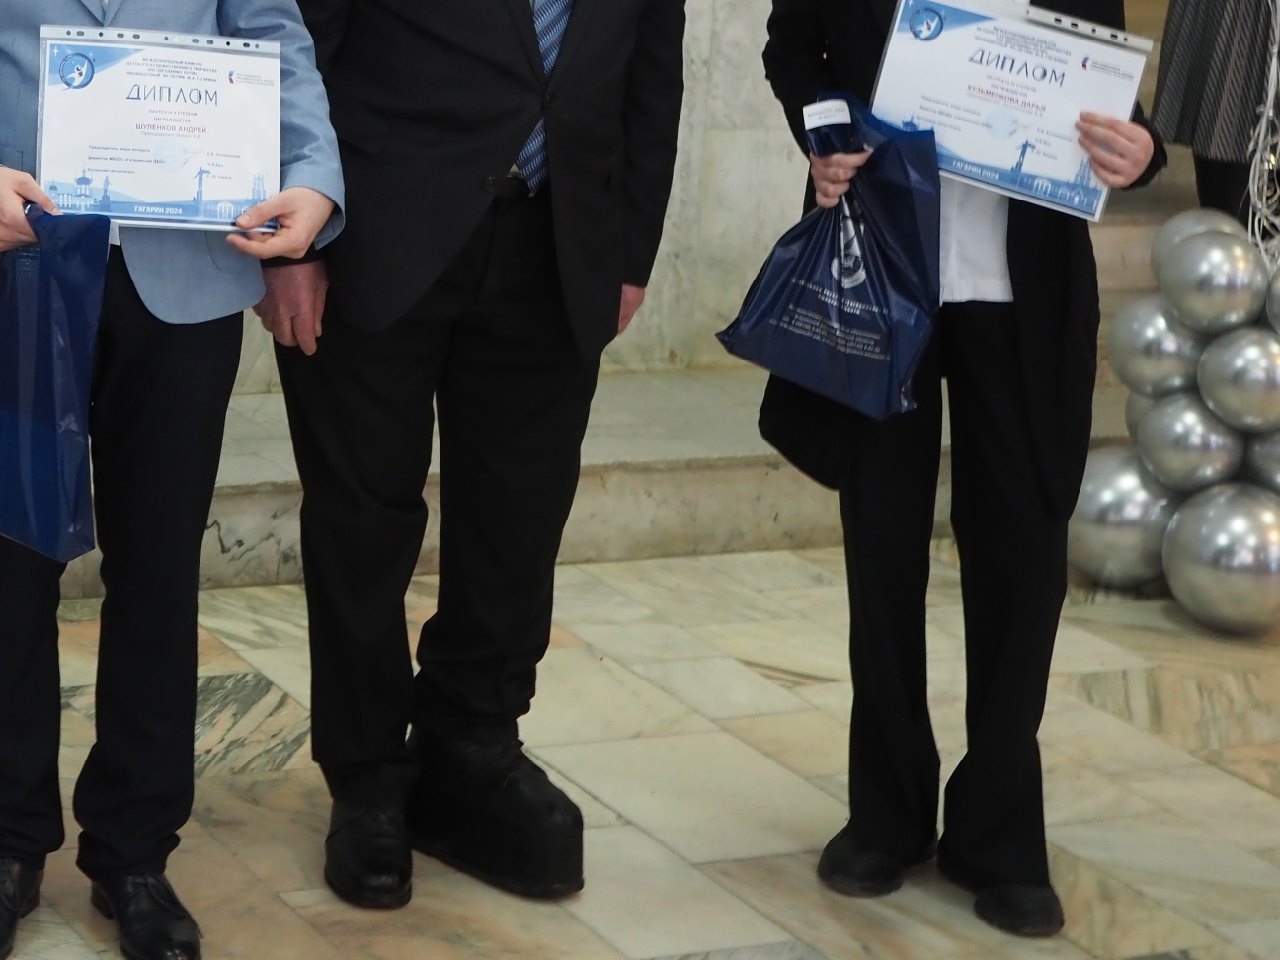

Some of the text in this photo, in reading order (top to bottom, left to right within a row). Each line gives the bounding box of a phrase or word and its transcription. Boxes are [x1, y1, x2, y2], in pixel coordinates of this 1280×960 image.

[967, 48, 1066, 88] ДИПЛОМ
[125, 83, 218, 107] ДИПЛОМ
[135, 123, 207, 134] ШУЛЕНКОВ АНДРЕЙ
[134, 205, 183, 215] ГАГАРИН 2024
